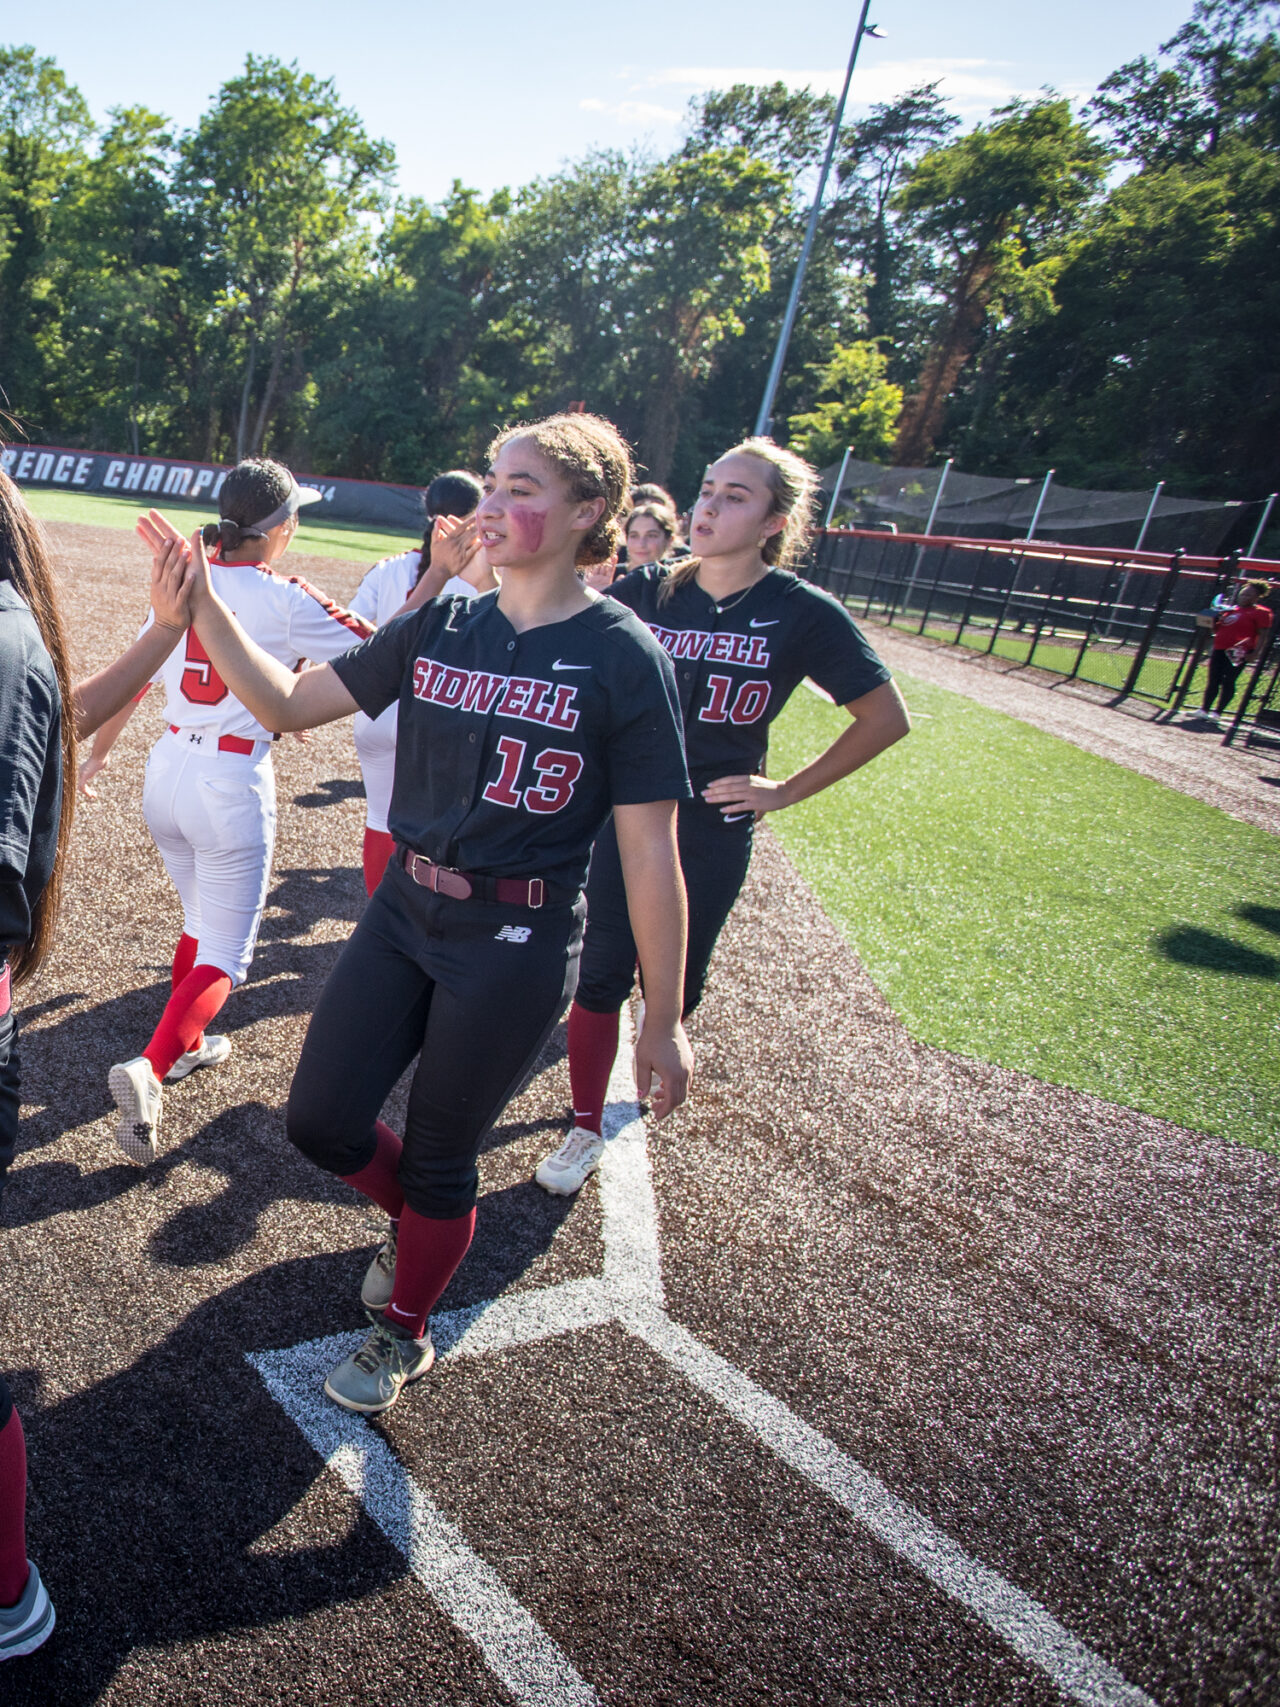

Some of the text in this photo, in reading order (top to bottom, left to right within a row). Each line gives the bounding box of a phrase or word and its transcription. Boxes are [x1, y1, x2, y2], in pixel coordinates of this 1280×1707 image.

[103, 460, 228, 499] CHAMPI
[644, 622, 770, 668] DWELL
[413, 656, 580, 732] SIDWELL
[698, 674, 771, 724] 10
[482, 735, 584, 814] 13
